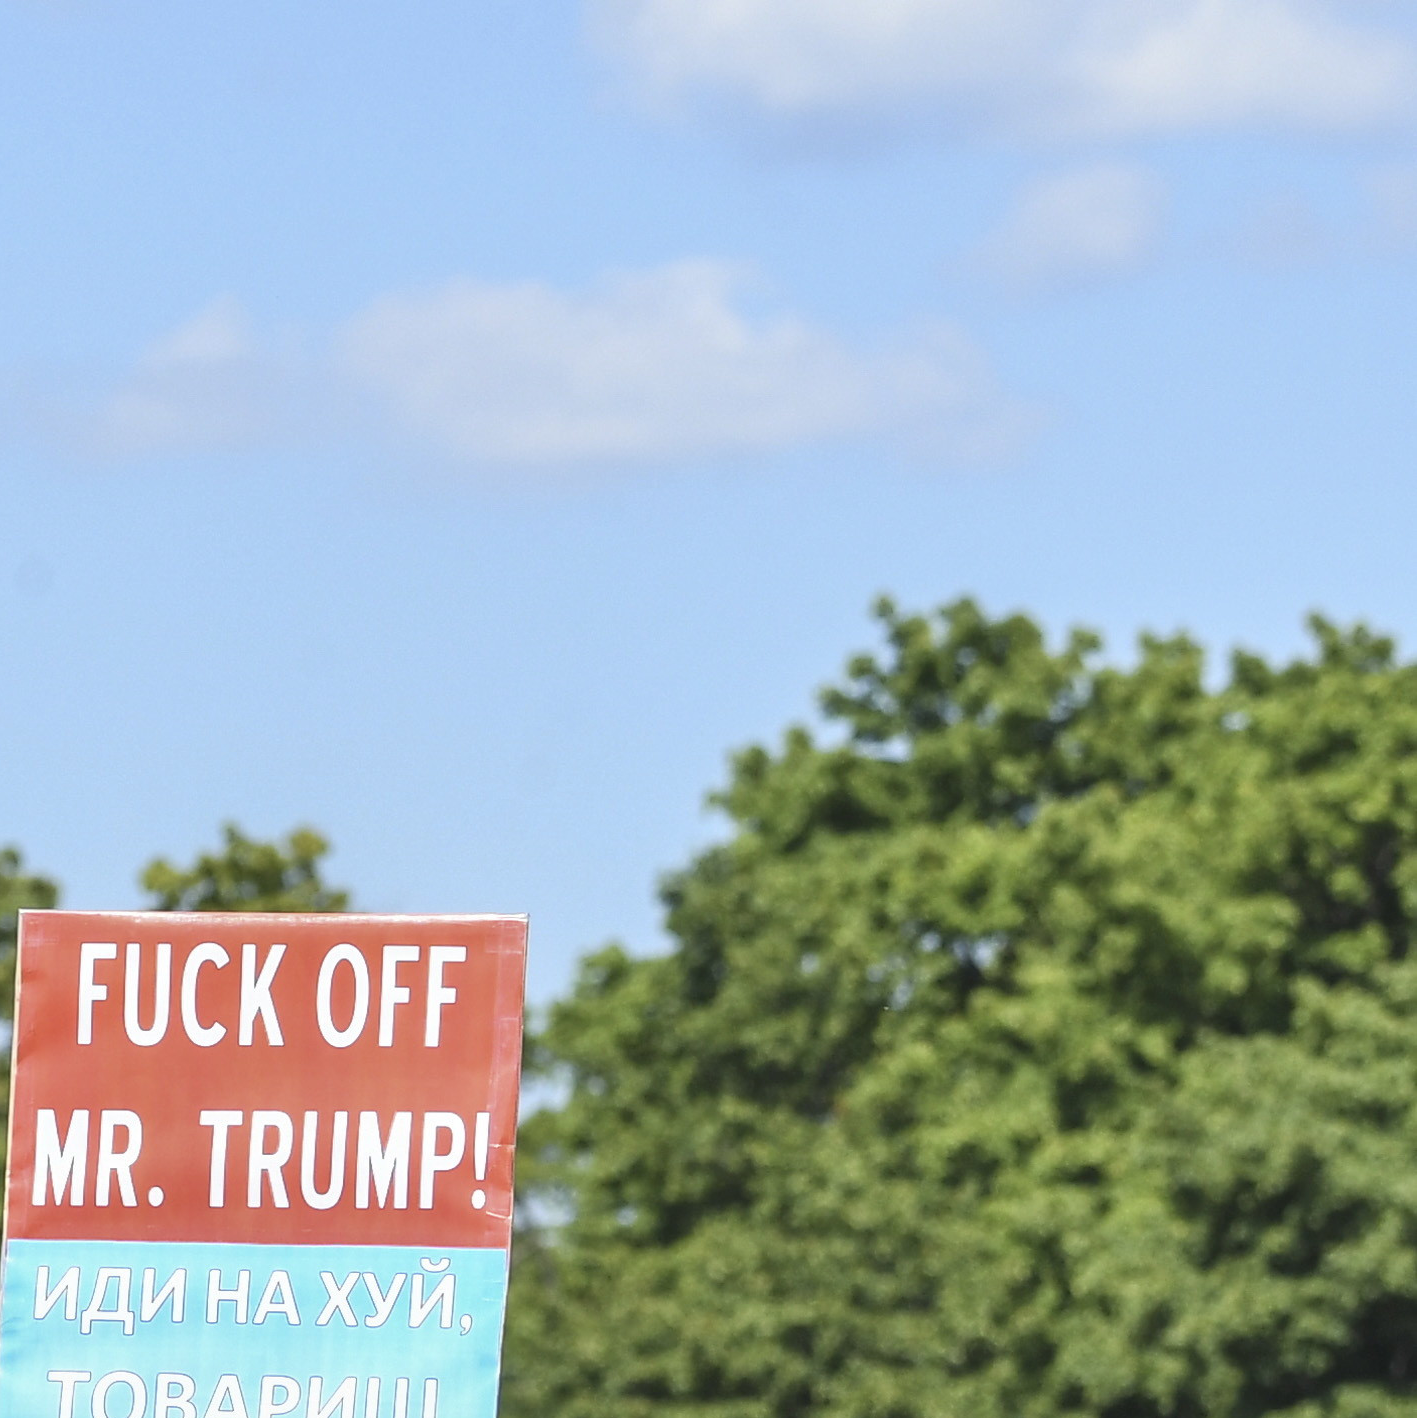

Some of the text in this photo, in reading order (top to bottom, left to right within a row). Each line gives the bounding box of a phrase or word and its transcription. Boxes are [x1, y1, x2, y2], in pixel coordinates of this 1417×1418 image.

[77, 942, 467, 1048] FUCK OFF
[31, 1108, 491, 1210] MR. TRUMP!
[33, 1257, 473, 1336] ИДИ НА ХУЙ,
